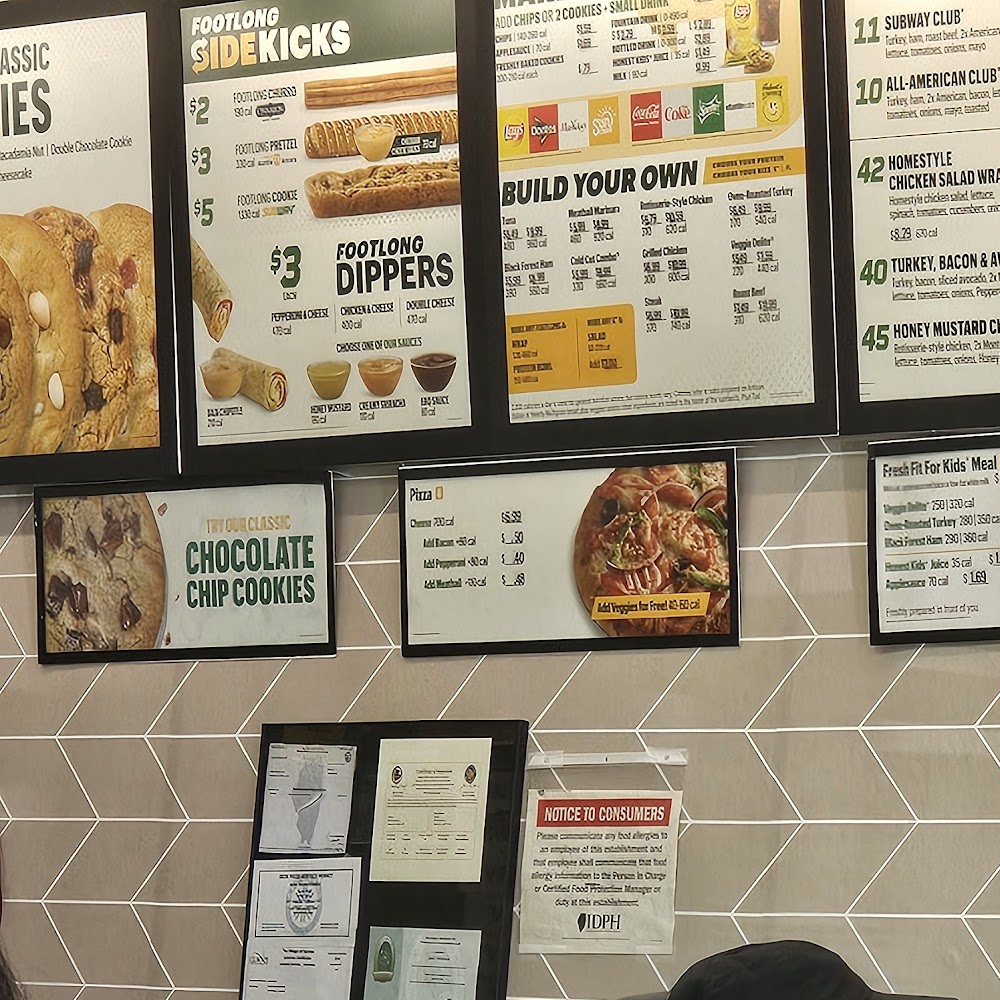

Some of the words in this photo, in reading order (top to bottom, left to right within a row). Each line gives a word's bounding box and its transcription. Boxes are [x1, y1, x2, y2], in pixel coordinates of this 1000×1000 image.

[192, 7, 279, 36] FOOTLONG
[495, 17, 512, 29] ADD
[513, 13, 540, 27] CHIPS
[555, 10, 561, 21] 2
[563, 4, 602, 20] COOKIES
[610, 1, 639, 13] SMALL
[854, 16, 880, 44] 11
[885, 12, 930, 30] SUBWAY
[191, 20, 350, 75] SIDEKICKS
[856, 78, 882, 105] 10
[887, 71, 966, 92] ALL-AMERICAN
[190, 97, 209, 125] $2
[191, 147, 211, 174] $3
[857, 156, 885, 183] 42
[889, 151, 952, 171] HOMESTYLE
[502, 176, 568, 206] BUILD
[574, 170, 637, 197] YOUR
[640, 160, 698, 190] OWN
[889, 173, 936, 190] CHICKEN
[939, 171, 975, 188] SALAD
[193, 198, 213, 226] $5
[337, 235, 424, 260] FOOTLONG
[271, 246, 301, 288] $3
[337, 253, 454, 295] DIPPERS
[860, 259, 888, 286] 40
[891, 256, 937, 273] TURKEY,
[939, 253, 978, 270] BACON
[980, 254, 988, 268] &
[862, 324, 889, 352] 45
[894, 322, 930, 338] HONEY
[933, 319, 986, 337] MUSTARD
[911, 462, 923, 475] Fit
[925, 461, 941, 474] For
[972, 455, 997, 471] Meal
[186, 535, 315, 575] CHOCOLATE
[187, 579, 229, 608] CHIP
[233, 575, 315, 607] COOKIES
[545, 807, 581, 822] NOTICE
[583, 807, 596, 821] TO
[599, 806, 665, 821] CONSUMERS
[587, 914, 621, 930] IDPH
